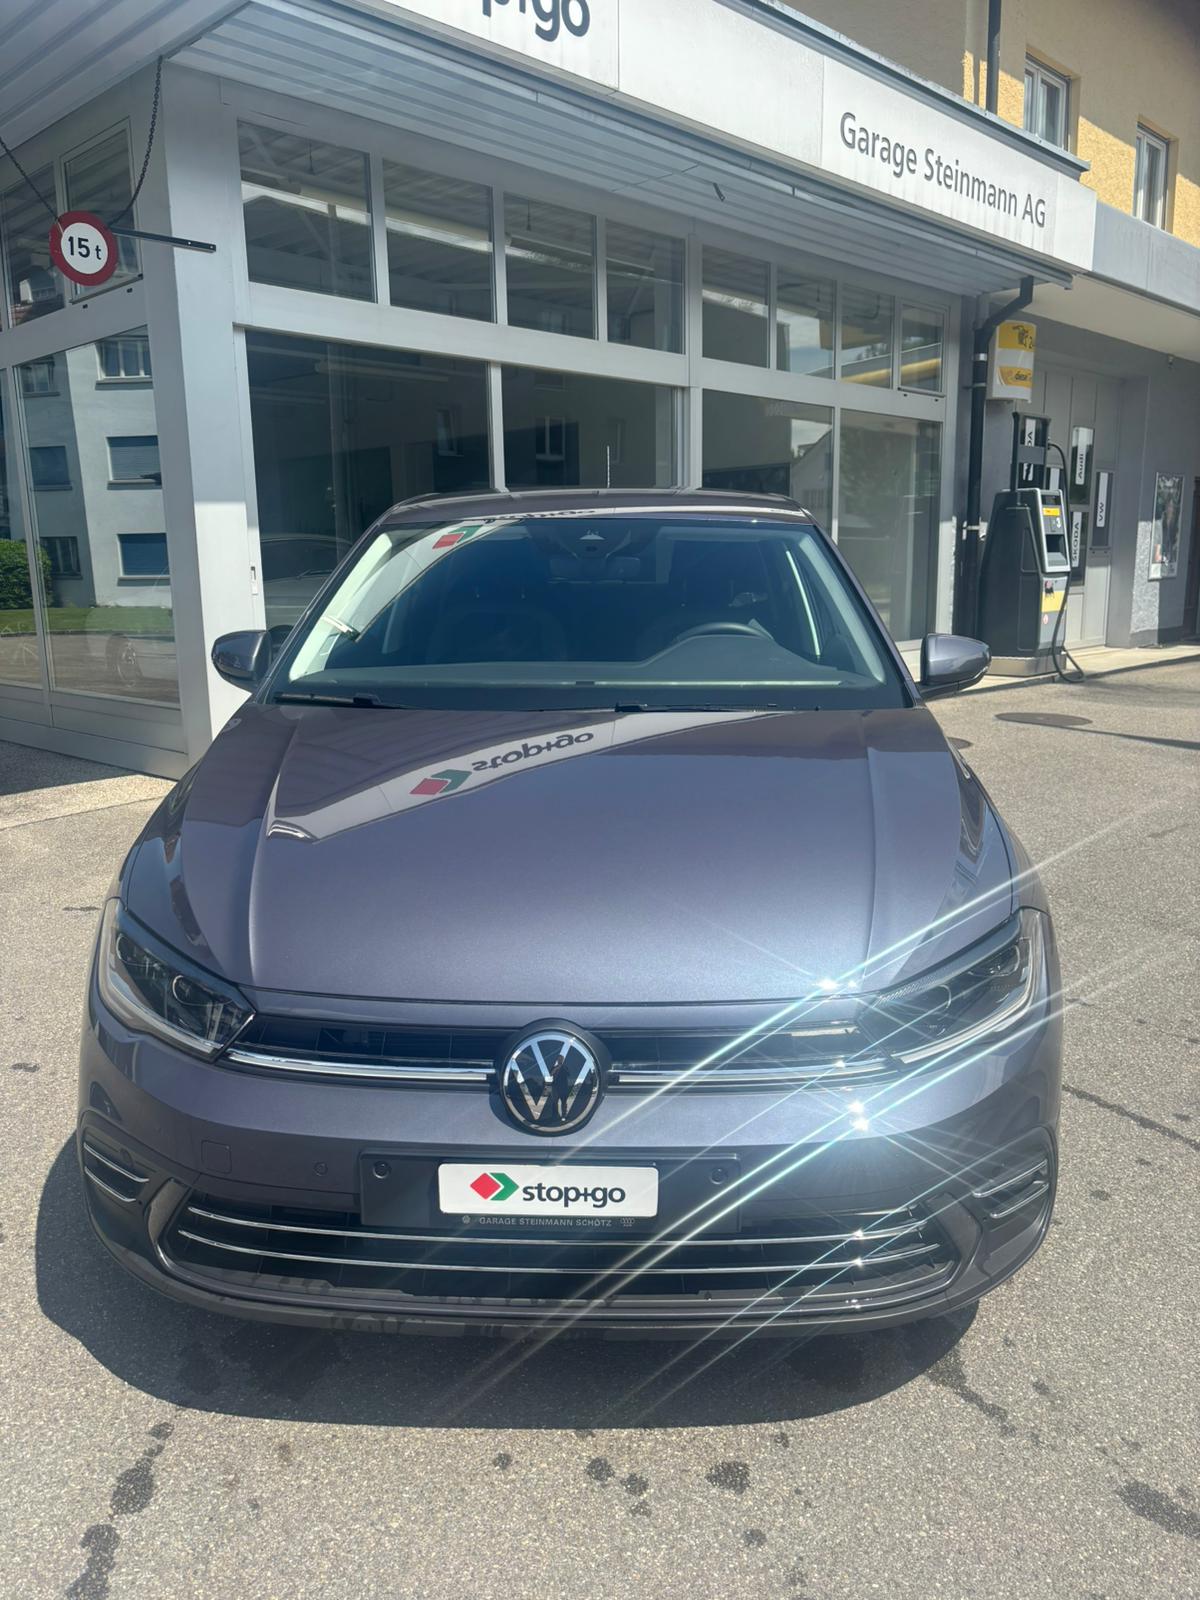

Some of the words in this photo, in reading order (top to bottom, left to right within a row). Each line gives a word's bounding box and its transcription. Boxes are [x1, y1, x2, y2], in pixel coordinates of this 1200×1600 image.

[840, 112, 917, 178] Garage
[924, 148, 1017, 217] Steinmann
[1022, 193, 1046, 228] AG
[68, 236, 90, 258] 15
[95, 245, 101, 260] t
[1098, 502, 1104, 521] VW
[522, 1182, 626, 1208] stop+go
[479, 1216, 516, 1225] GARAGE
[519, 1217, 573, 1226] STEINMANN
[576, 1217, 612, 1227] SCHÖTZ
